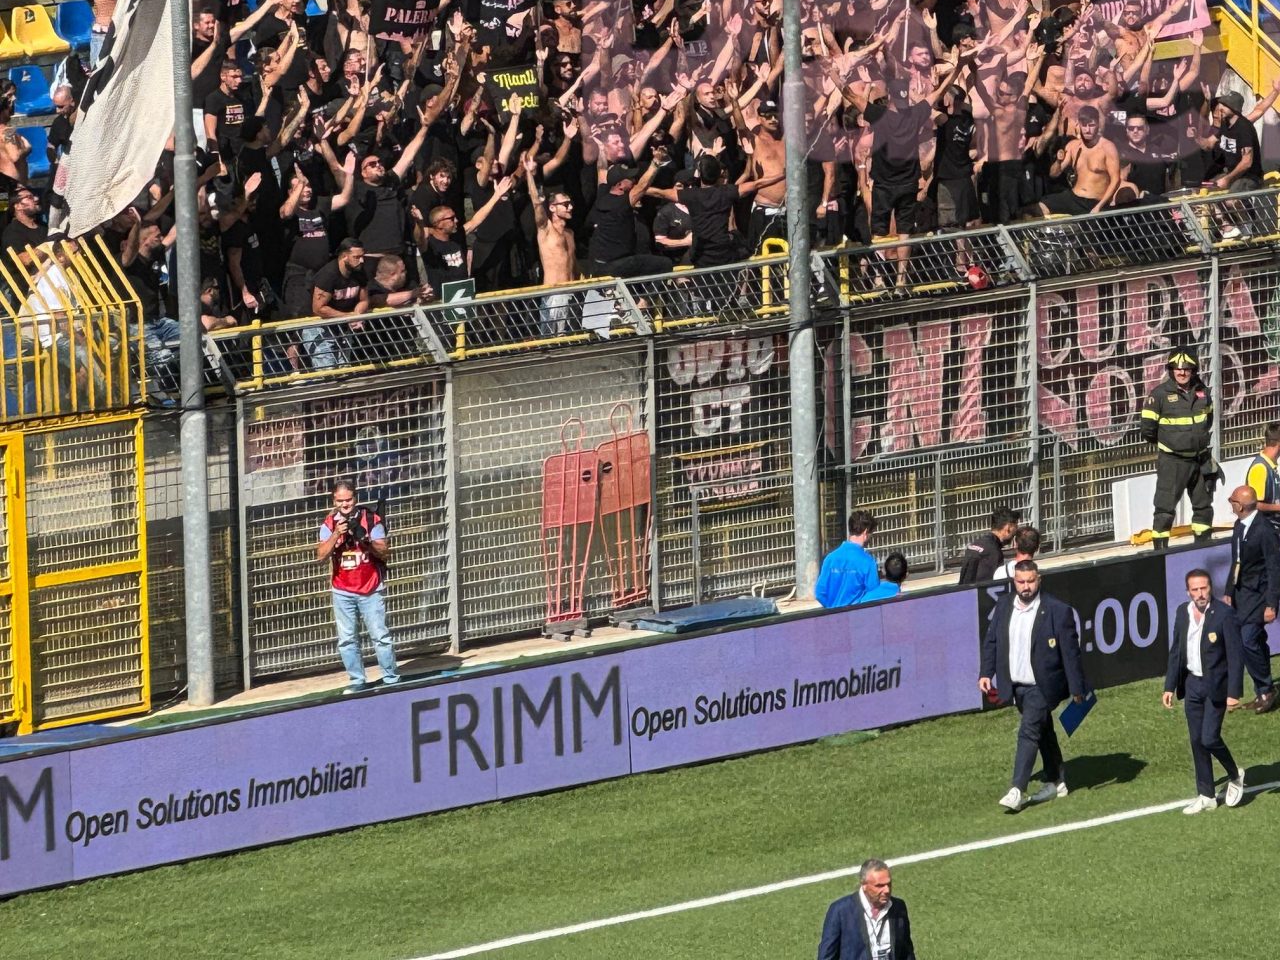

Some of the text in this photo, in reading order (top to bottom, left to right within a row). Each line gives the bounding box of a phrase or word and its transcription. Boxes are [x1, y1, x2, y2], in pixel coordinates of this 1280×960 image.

[1037, 266, 1262, 370] CURVA
[409, 665, 624, 784] FRIMM
[630, 660, 903, 738] Open Solutions Immobiliari
[64, 808, 129, 847] Open
[135, 785, 241, 831] Solutions
[247, 755, 369, 811] Immobiliari
